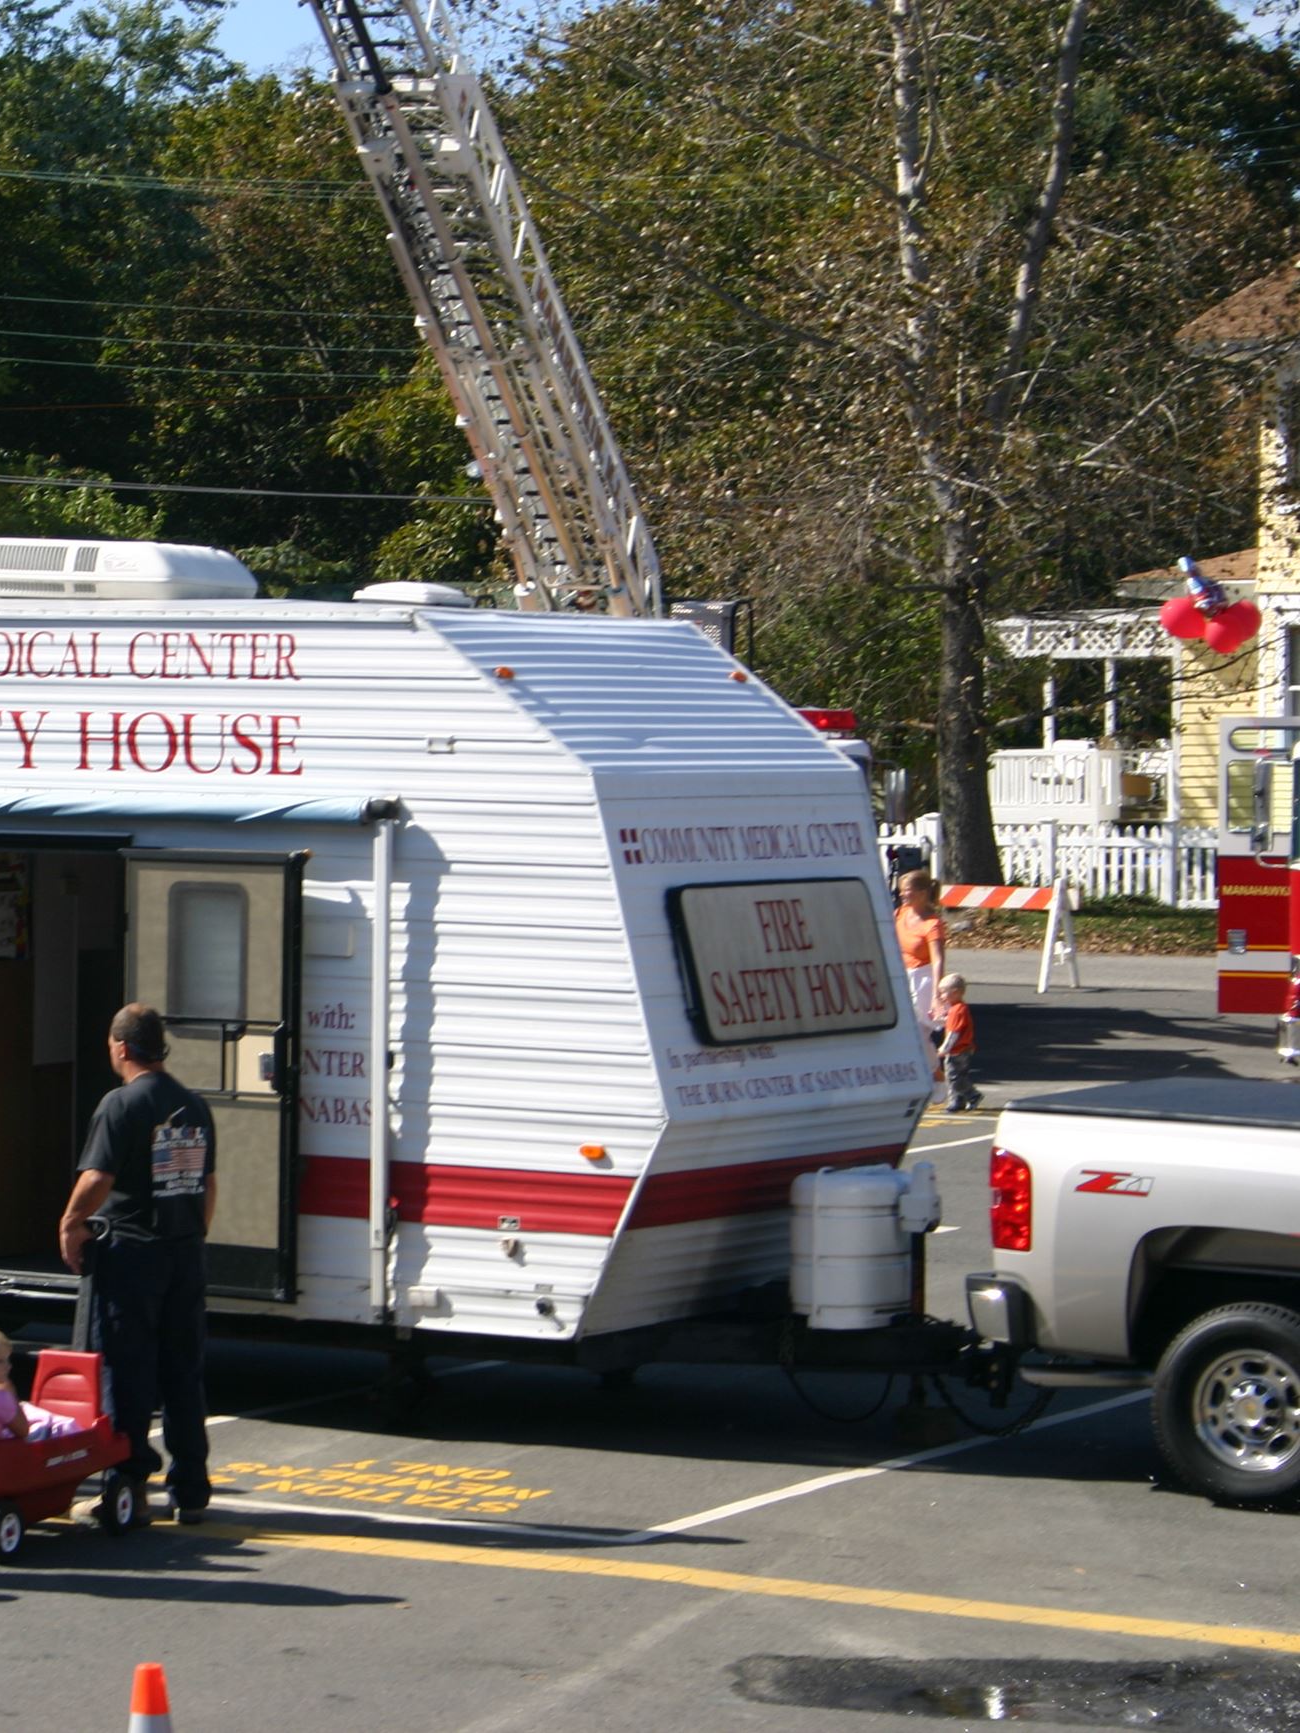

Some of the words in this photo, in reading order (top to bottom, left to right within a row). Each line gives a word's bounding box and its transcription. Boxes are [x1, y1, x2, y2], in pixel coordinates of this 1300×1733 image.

[128, 631, 301, 681] CENTER
[76, 711, 303, 776] HOUSE
[641, 826, 737, 864] COMMUNITY
[738, 825, 807, 860] MEDICAL
[808, 822, 867, 857] CENTER
[755, 899, 813, 953] FIRE
[710, 966, 803, 1026] SAFETY
[803, 960, 885, 1018] HOUSE
[307, 1002, 356, 1030] with:
[300, 1049, 366, 1078] NTER
[675, 1084, 706, 1106] THE
[745, 1074, 797, 1099] CENTER
[815, 1067, 854, 1091] SAINT
[299, 1096, 372, 1126] NABAS
[1074, 1170, 1157, 1198] Z71
[217, 1462, 552, 1500] MEMBERS
[330, 1459, 511, 1480] ONLY
[252, 1479, 519, 1514] STATION
